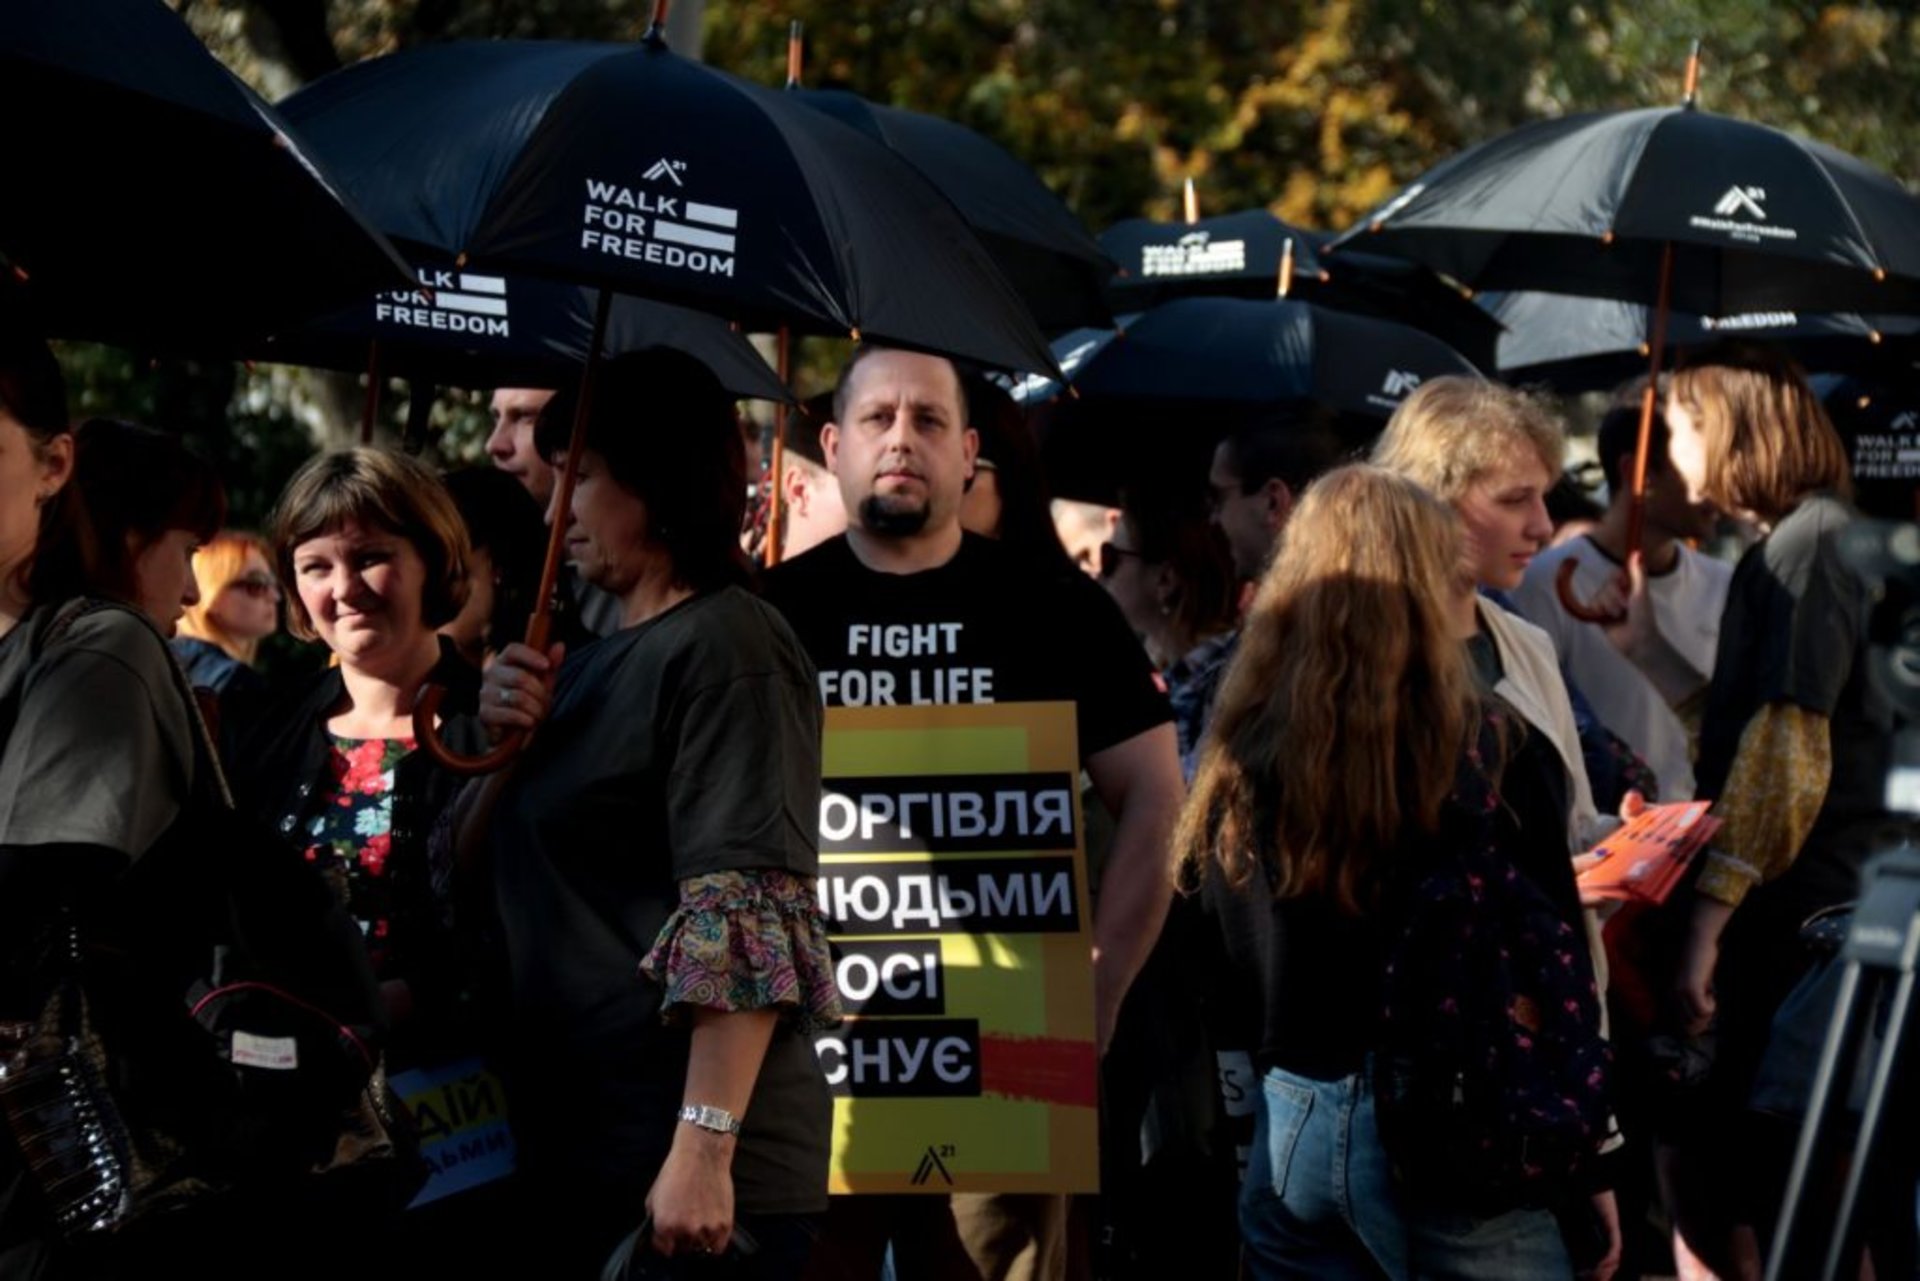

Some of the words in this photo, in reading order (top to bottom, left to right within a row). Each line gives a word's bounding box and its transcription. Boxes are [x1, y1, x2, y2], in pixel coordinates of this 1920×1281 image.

[586, 178, 679, 218] WALK
[583, 204, 647, 236] FOR
[581, 229, 736, 277] FREEDOM
[1142, 259, 1245, 277] FREEDOM
[418, 268, 454, 289] LK
[375, 289, 432, 307] OR
[375, 303, 510, 338] FREEDOM
[1854, 463, 1920, 478] FREED
[848, 622, 963, 658] FIGHT
[818, 669, 897, 707] FOR
[910, 668, 995, 706] LIFE
[818, 789, 1073, 841] ОРГІВЛЯ
[816, 871, 1072, 929] ЮДЬМИ
[835, 953, 938, 1001] ОСІ
[814, 1036, 972, 1085] СНУЄ
